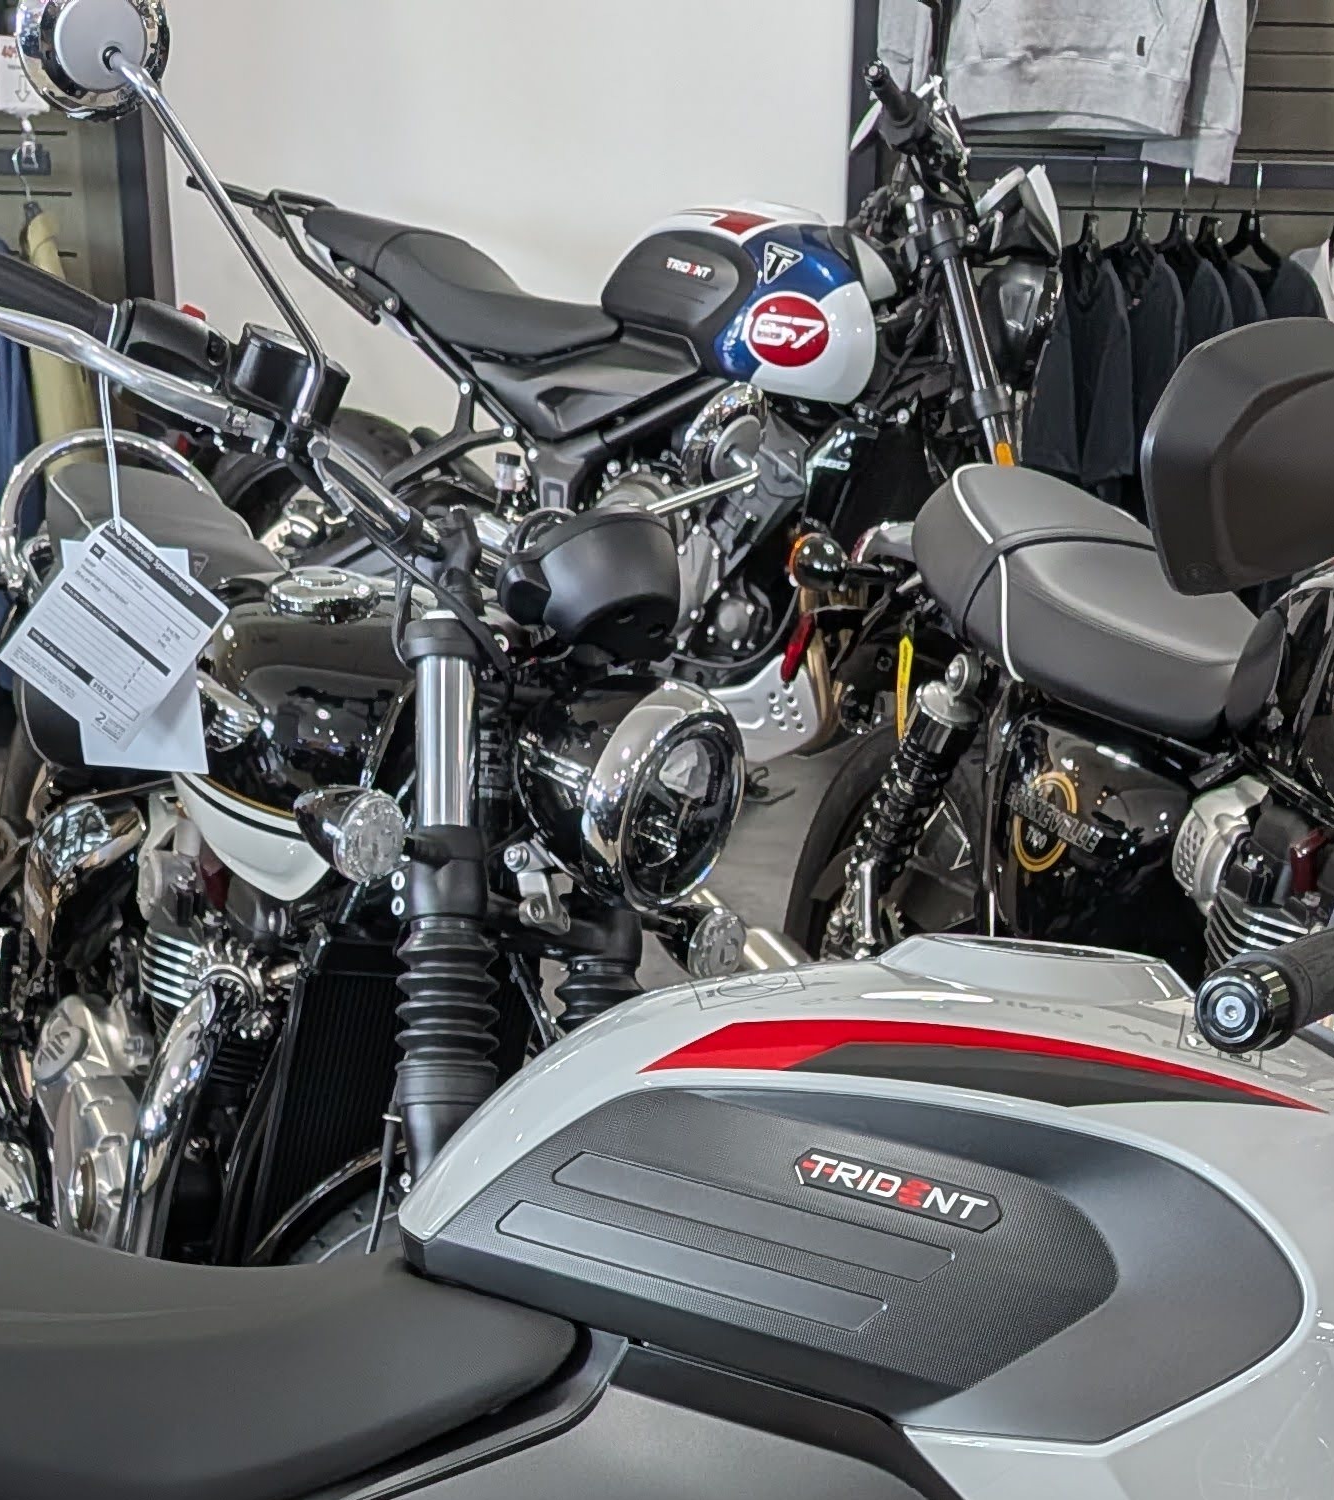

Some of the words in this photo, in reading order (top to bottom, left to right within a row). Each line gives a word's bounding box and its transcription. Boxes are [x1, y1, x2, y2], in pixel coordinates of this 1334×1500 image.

[121, 531, 154, 563] Bonneville
[151, 558, 195, 596] Speedmaster
[809, 1154, 989, 1219] TRIDENT
